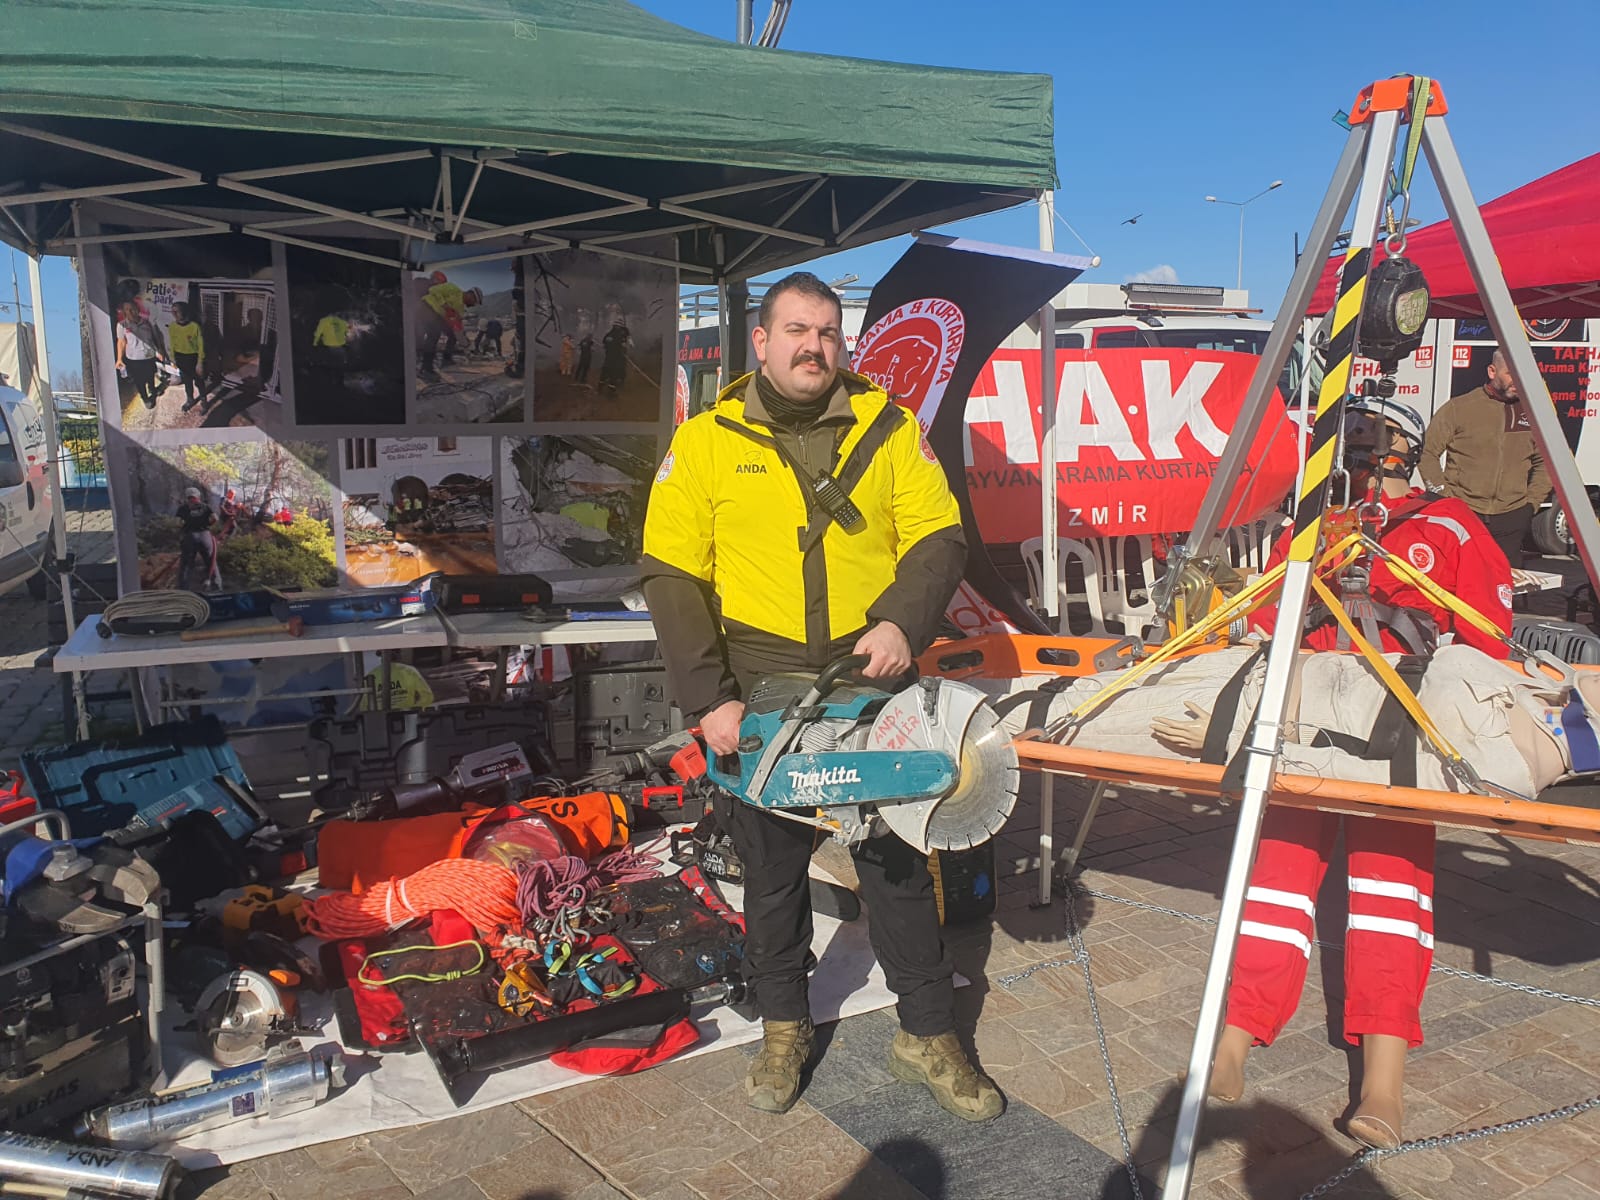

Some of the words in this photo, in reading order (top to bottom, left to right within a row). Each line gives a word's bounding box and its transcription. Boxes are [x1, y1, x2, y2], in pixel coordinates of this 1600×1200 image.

[850, 308, 904, 371] ARAMA
[909, 301, 924, 314] &
[924, 299, 964, 386] KURTARMA
[1417, 348, 1431, 359] 112
[1455, 347, 1468, 359] 112
[1552, 346, 1600, 360] TAFH
[1578, 377, 1591, 386] ve
[1567, 406, 1597, 417] Aracı
[735, 464, 767, 474] ANDA
[966, 468, 1042, 489] AYVAN
[1055, 465, 1132, 484] ARAMA
[1068, 502, 1147, 527] ZMİR
[875, 706, 903, 744] ANDA
[882, 715, 920, 750] ZMİR
